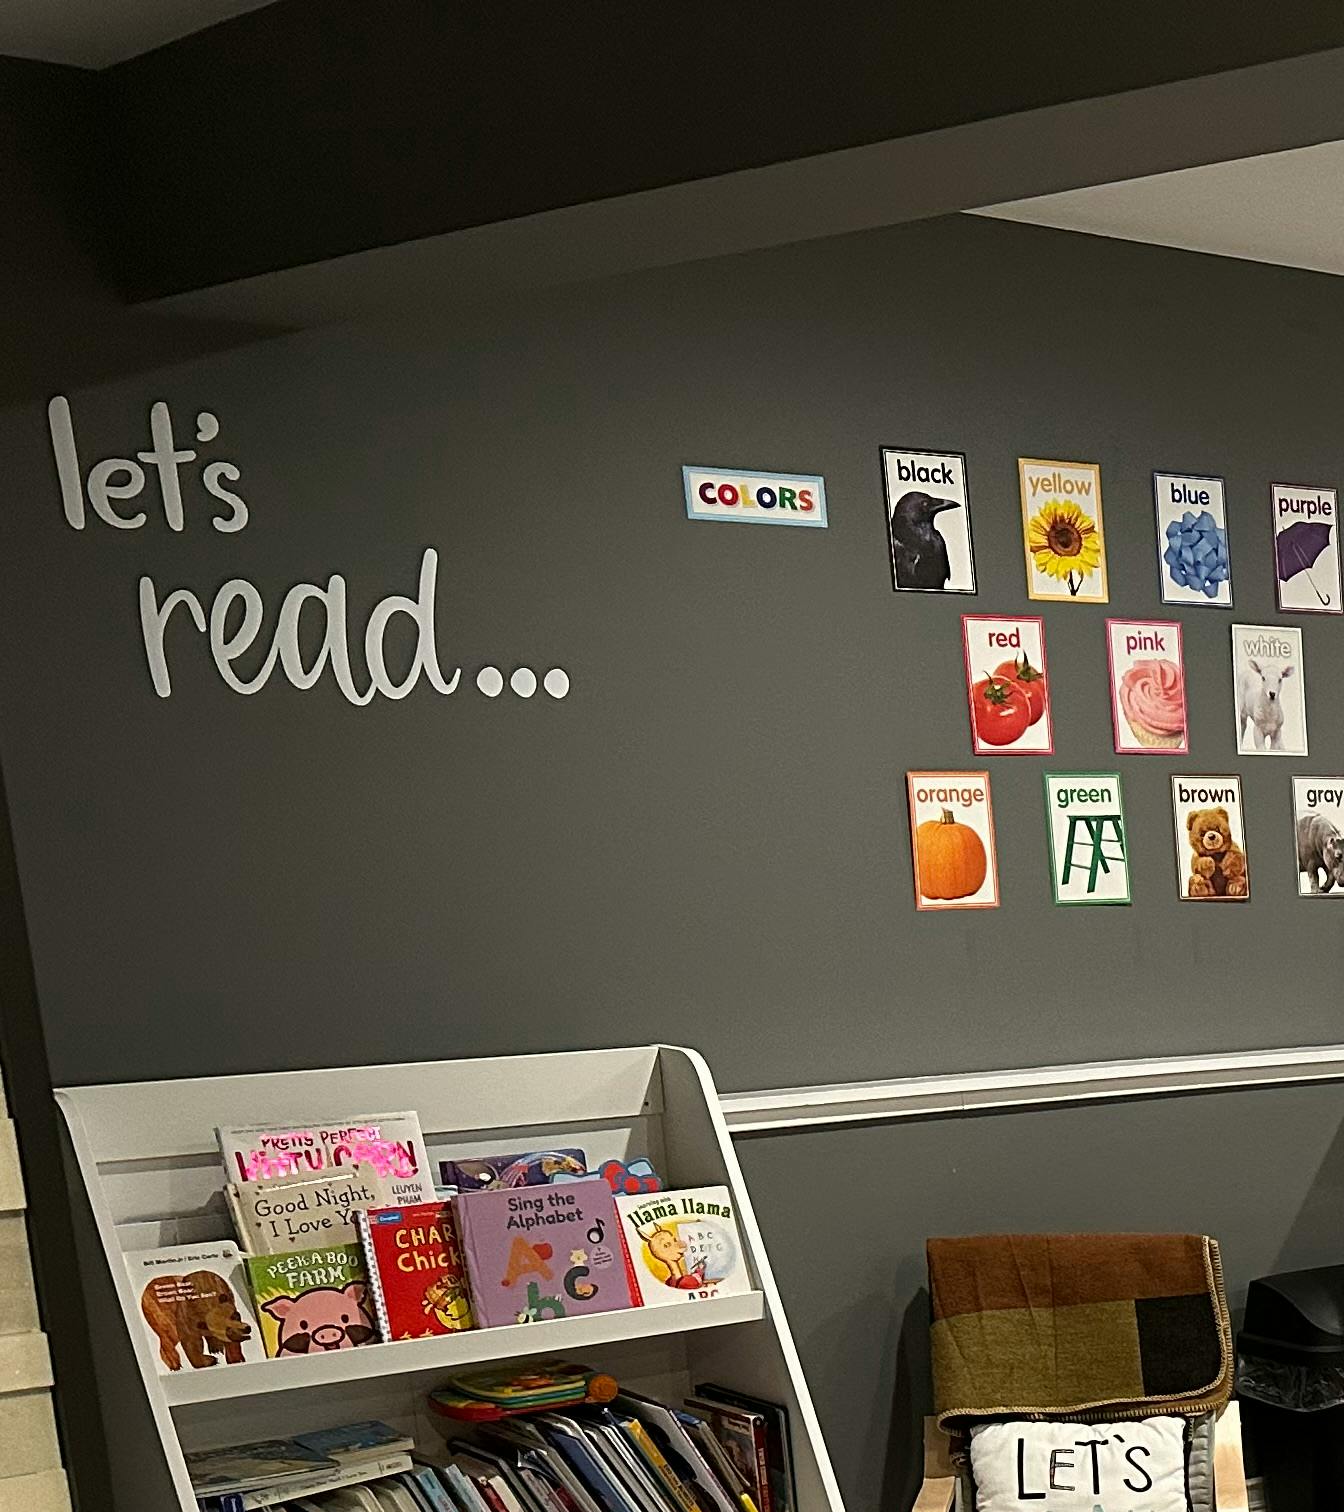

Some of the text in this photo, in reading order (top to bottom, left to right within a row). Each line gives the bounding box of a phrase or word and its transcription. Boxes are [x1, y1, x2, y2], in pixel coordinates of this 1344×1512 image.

[48, 396, 249, 533] let's
[897, 459, 954, 485] black
[699, 482, 815, 511] COLORS
[1029, 472, 1092, 497] yellow
[1170, 483, 1210, 506] blue
[1278, 495, 1332, 519] purple
[140, 548, 570, 706] read...
[988, 627, 1021, 648] red
[1126, 631, 1165, 655] pink
[1243, 635, 1292, 658] white
[916, 785, 985, 808] orange
[1056, 786, 1112, 809] green
[1178, 783, 1236, 804] brown
[1306, 787, 1344, 808] gray
[254, 1185, 375, 1217] Good Night,
[508, 1192, 575, 1212] Sing the
[506, 1208, 583, 1231] Alphabet
[627, 1198, 731, 1229] llama llama
[269, 1218, 332, 1238] I Love
[396, 1224, 456, 1249] CHAR
[397, 1246, 462, 1273] Chick
[501, 1234, 555, 1288] A
[286, 1266, 346, 1289] FARM
[1017, 1434, 1153, 1500] LET'S
